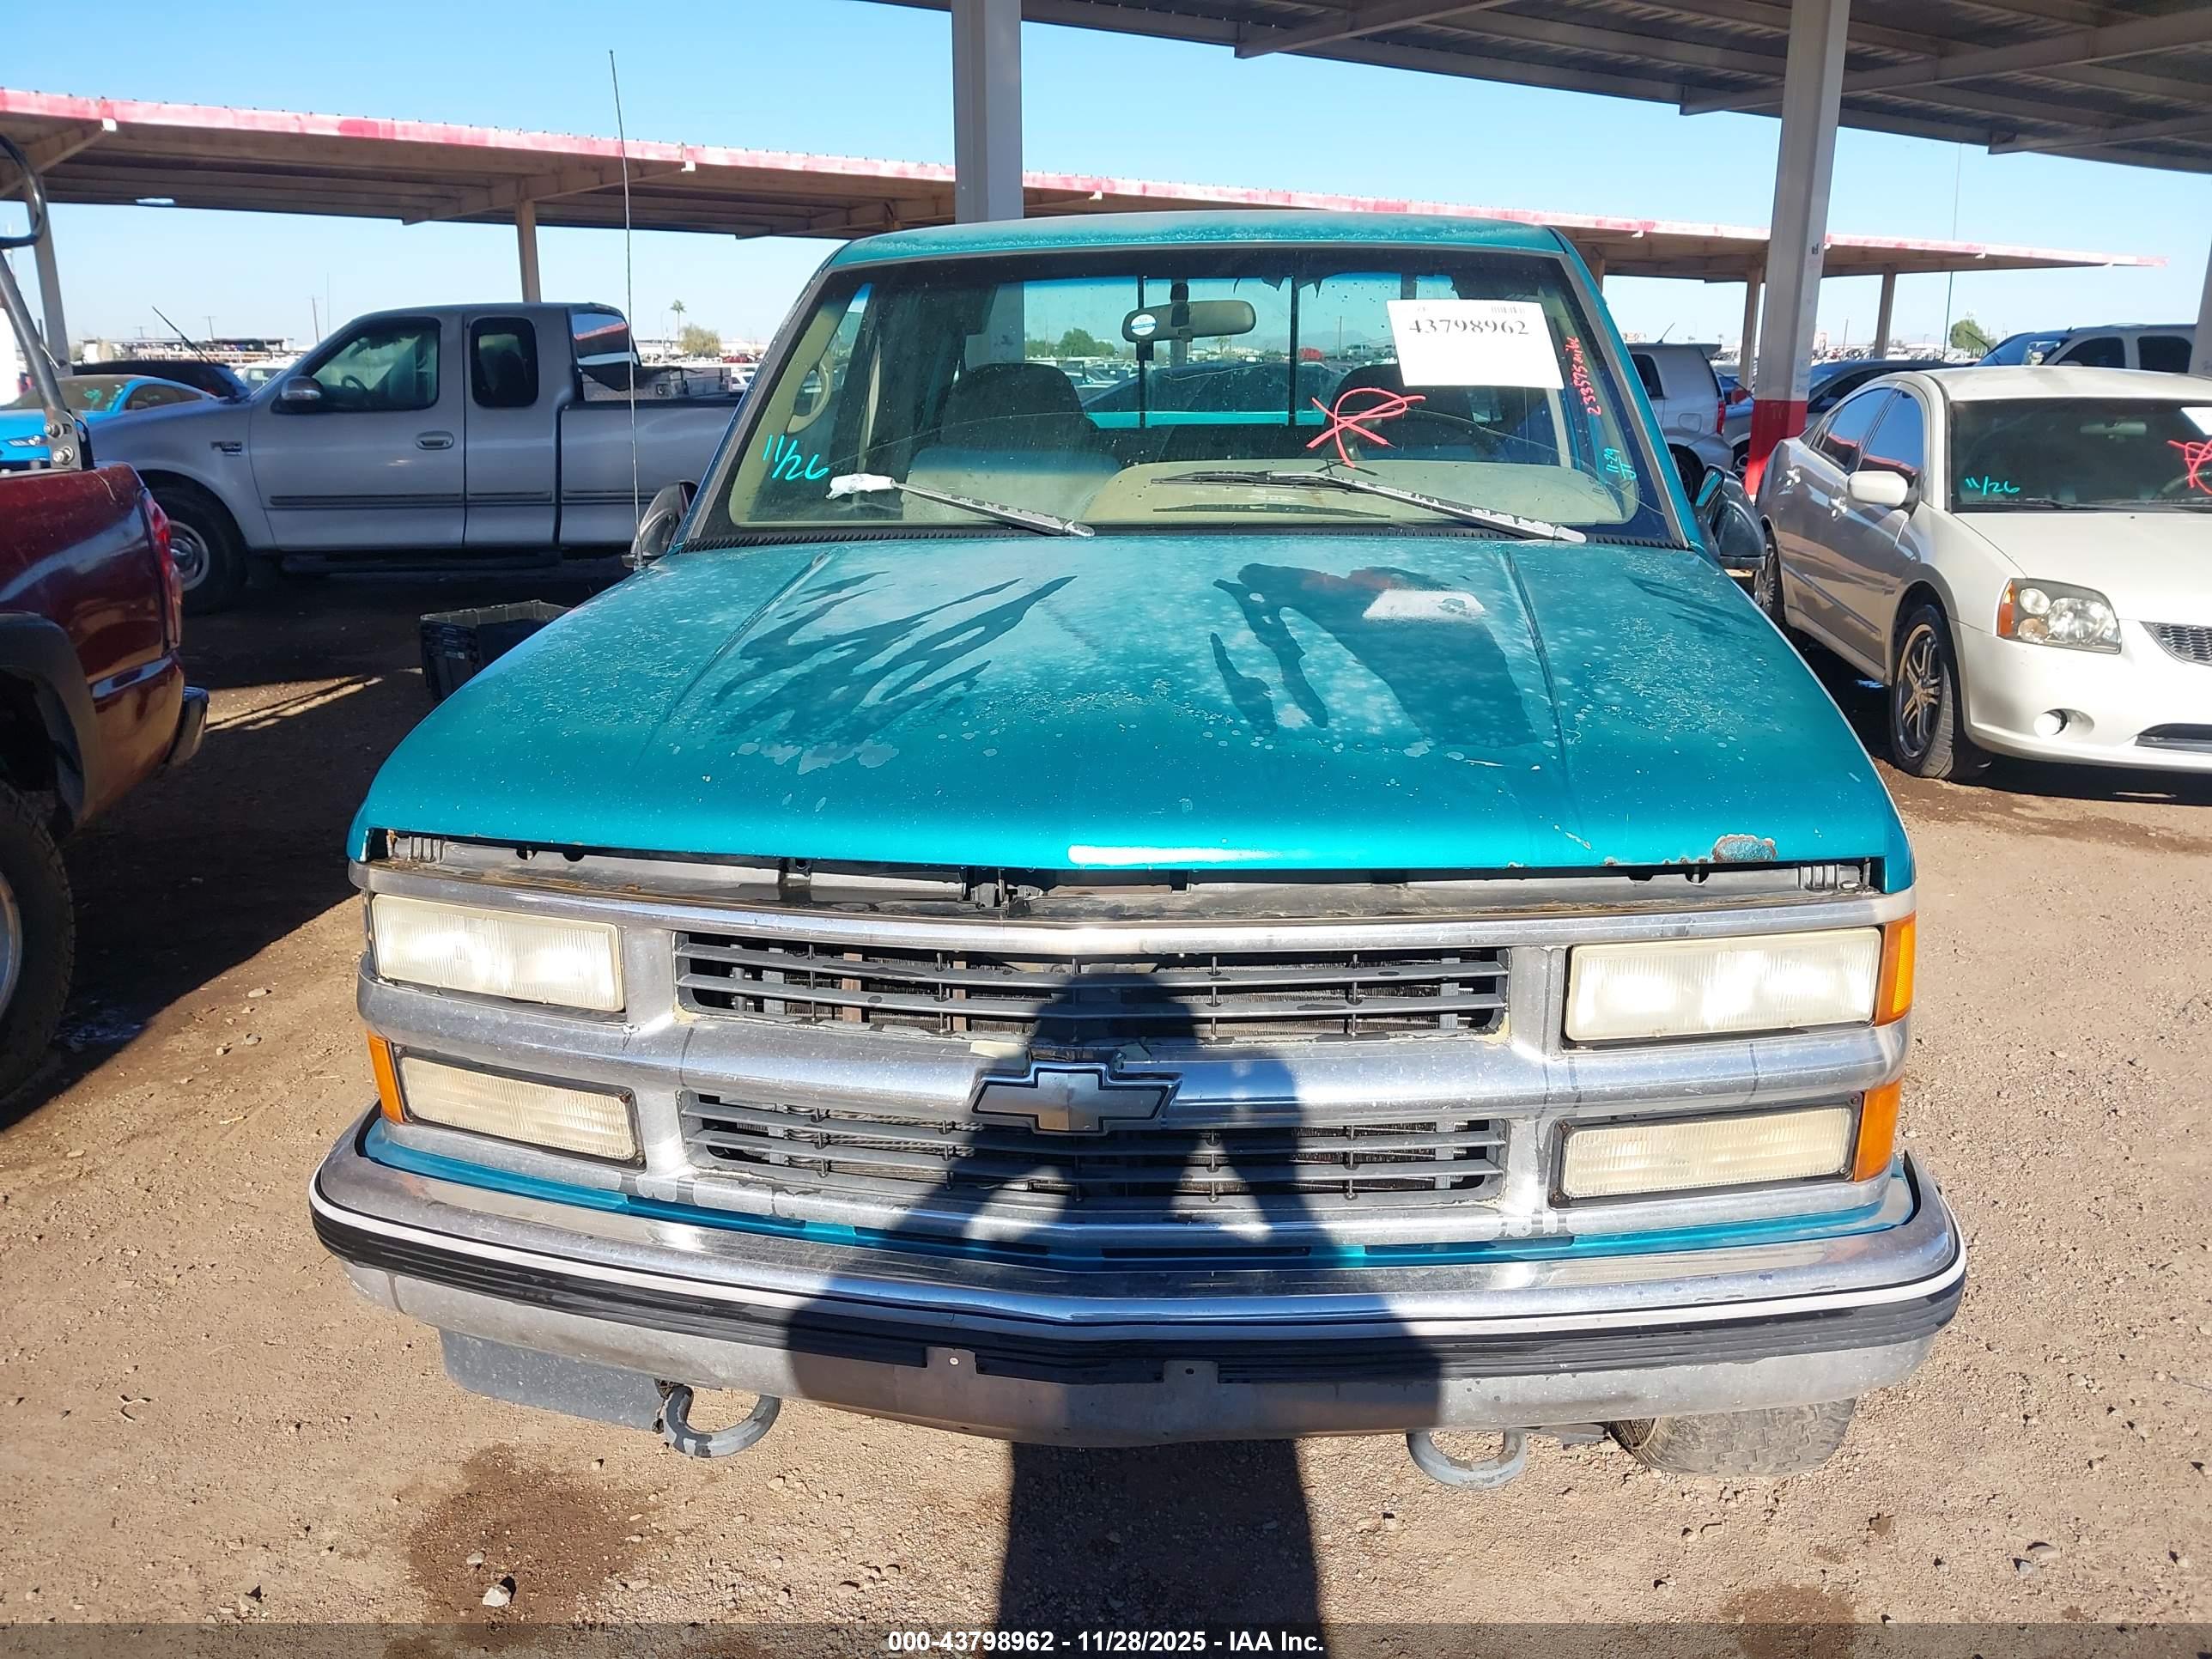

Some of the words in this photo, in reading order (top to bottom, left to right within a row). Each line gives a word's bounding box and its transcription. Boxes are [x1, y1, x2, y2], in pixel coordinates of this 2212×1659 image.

[1408, 319, 1529, 337] 43798962
[763, 434, 830, 481] 11/26
[1965, 476, 2021, 495] 11/26
